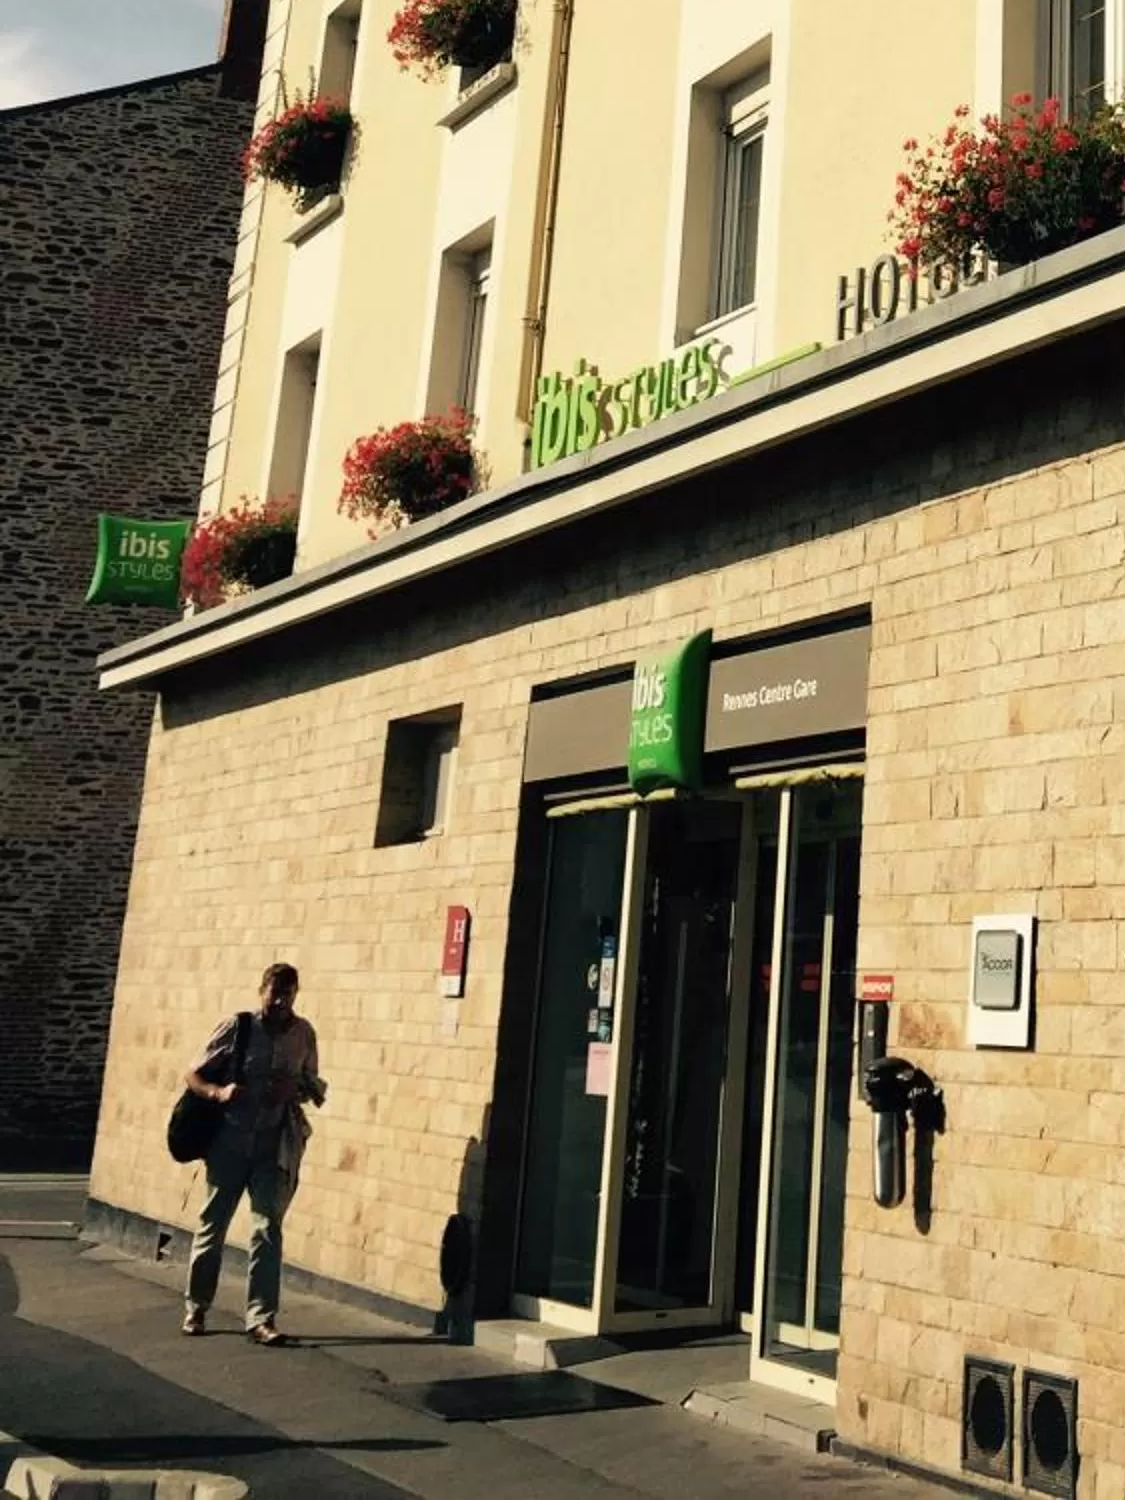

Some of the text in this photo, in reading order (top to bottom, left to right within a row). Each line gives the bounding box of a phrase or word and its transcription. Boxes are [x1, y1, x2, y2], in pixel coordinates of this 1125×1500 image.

[532, 358, 600, 474] ibis
[118, 530, 171, 560] ibis
[632, 662, 666, 711] ibis
[722, 677, 817, 713] Rennes Centre Gare
